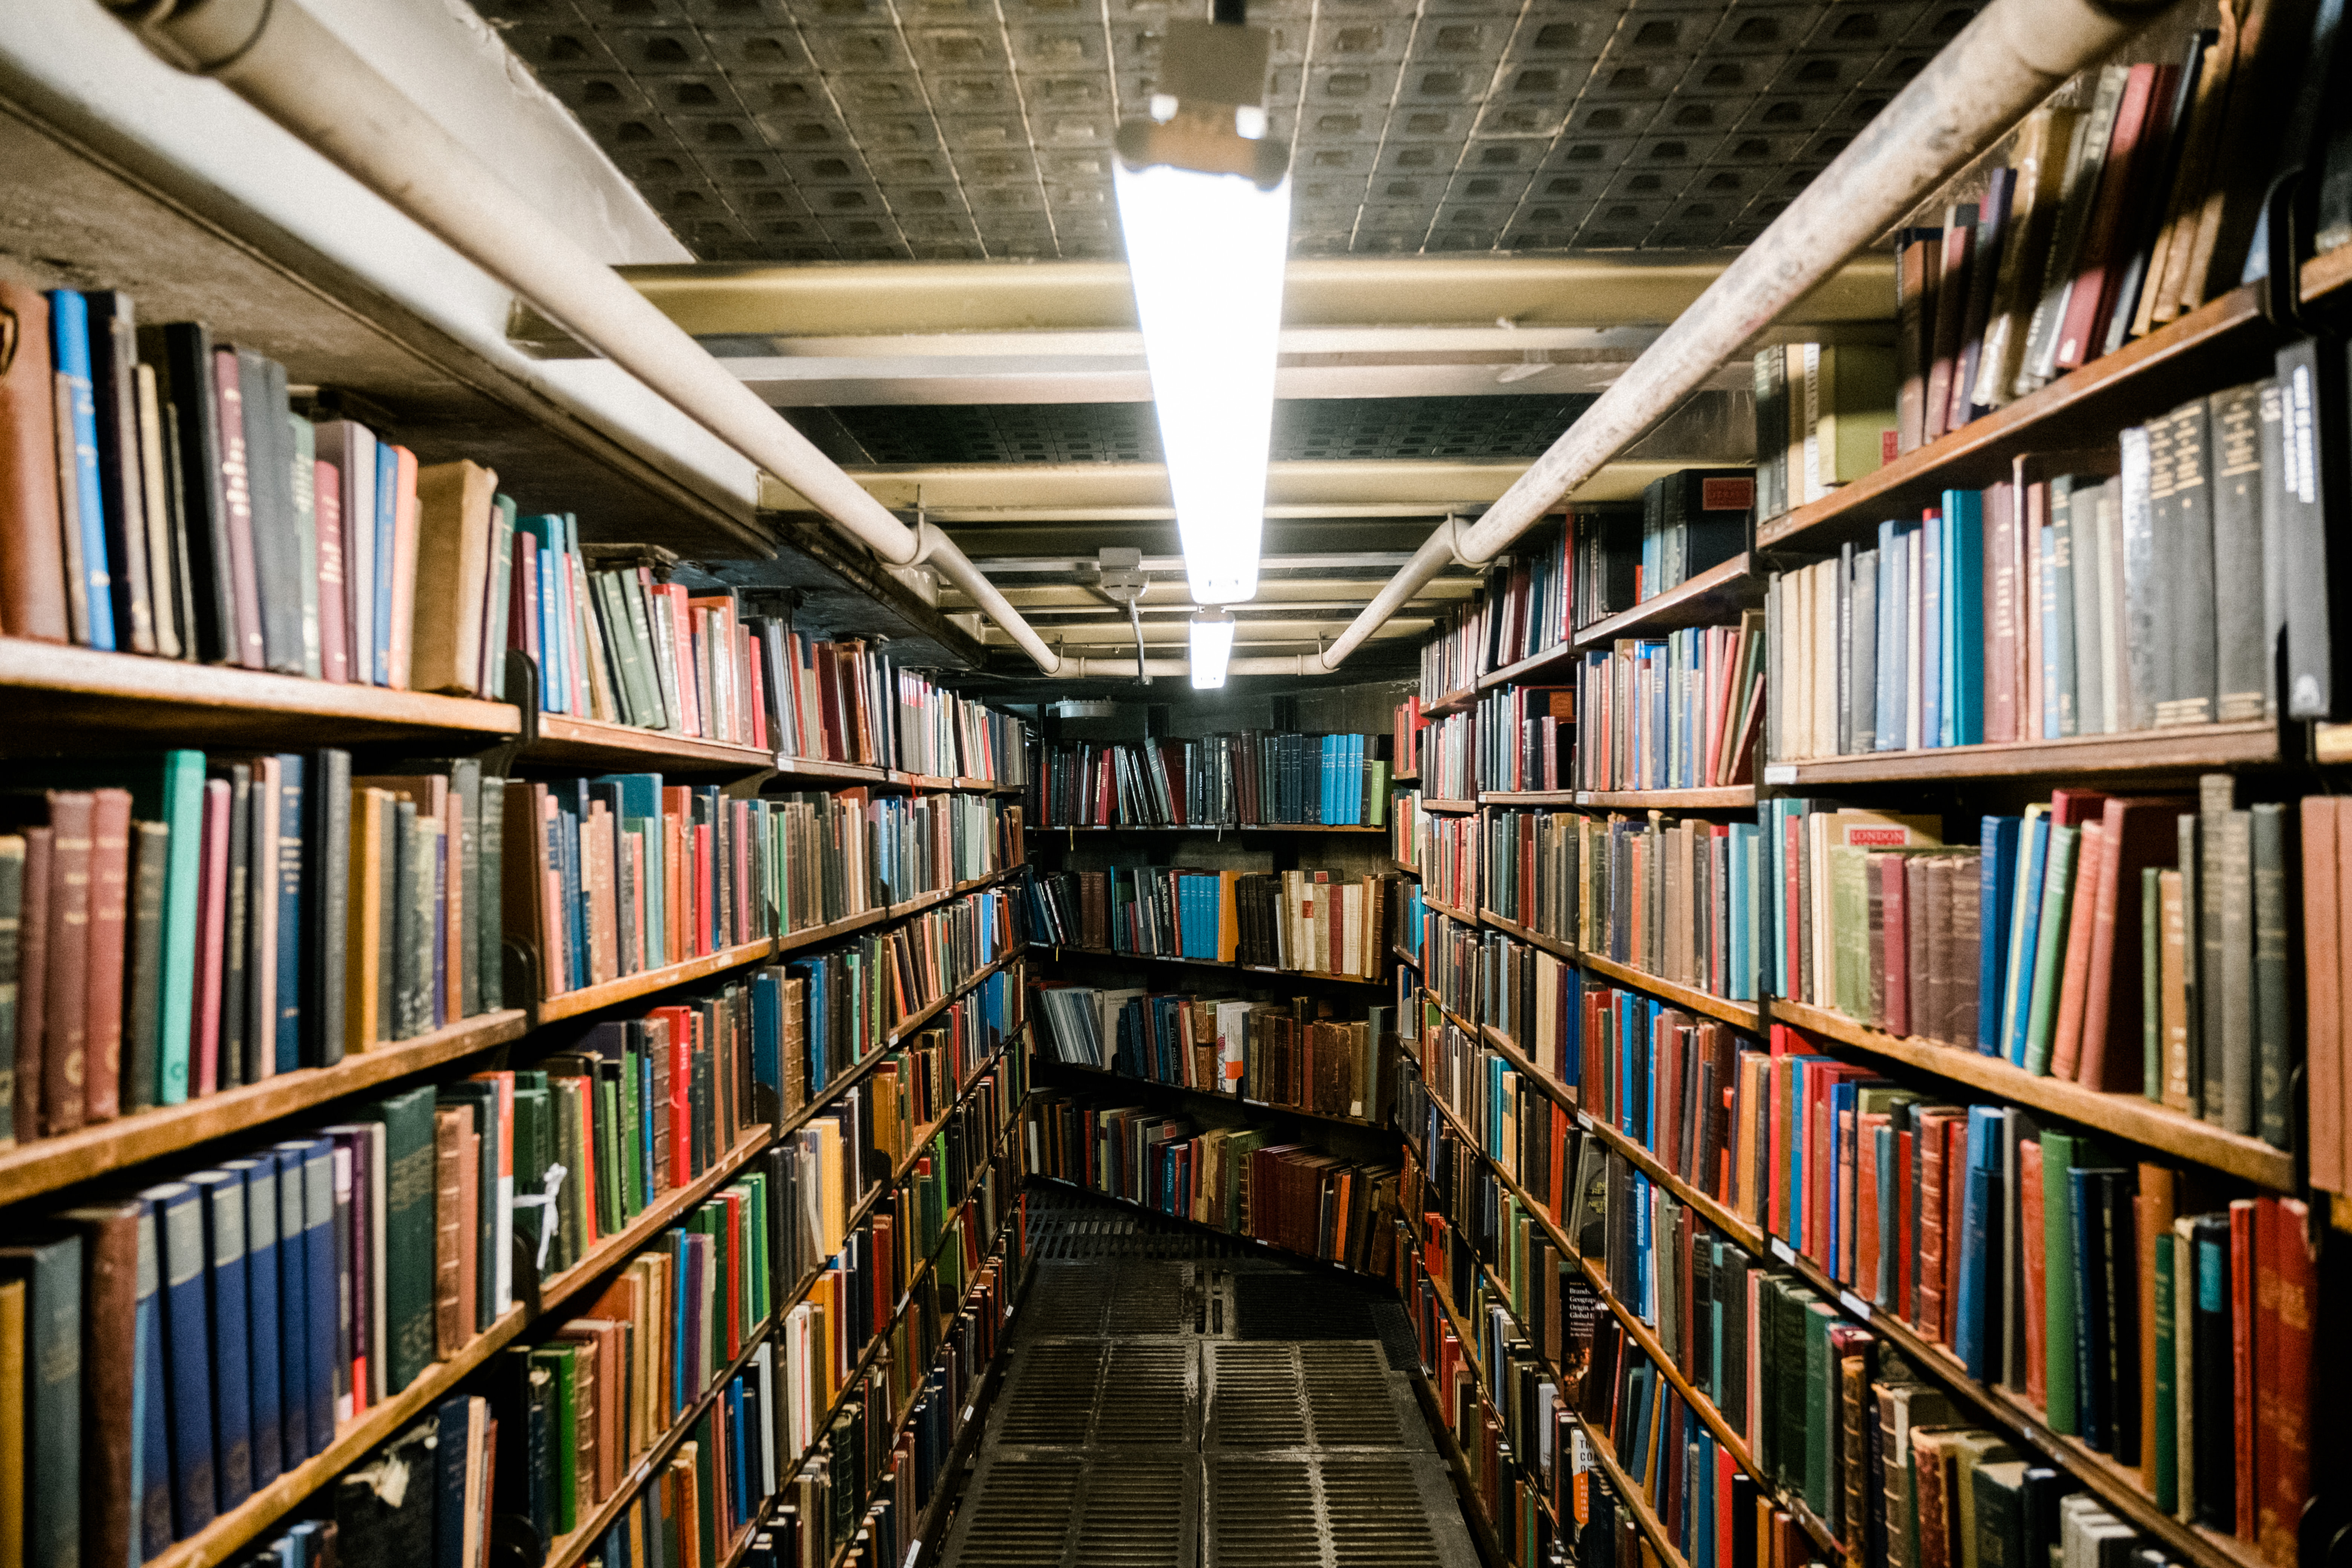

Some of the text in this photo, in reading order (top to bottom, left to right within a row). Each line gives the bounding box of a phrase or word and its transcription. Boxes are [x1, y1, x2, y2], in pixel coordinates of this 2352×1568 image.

[1851, 830, 1903, 841] LONDON
[1580, 1439, 1591, 1449] TH
[1581, 1465, 1586, 1474] O
